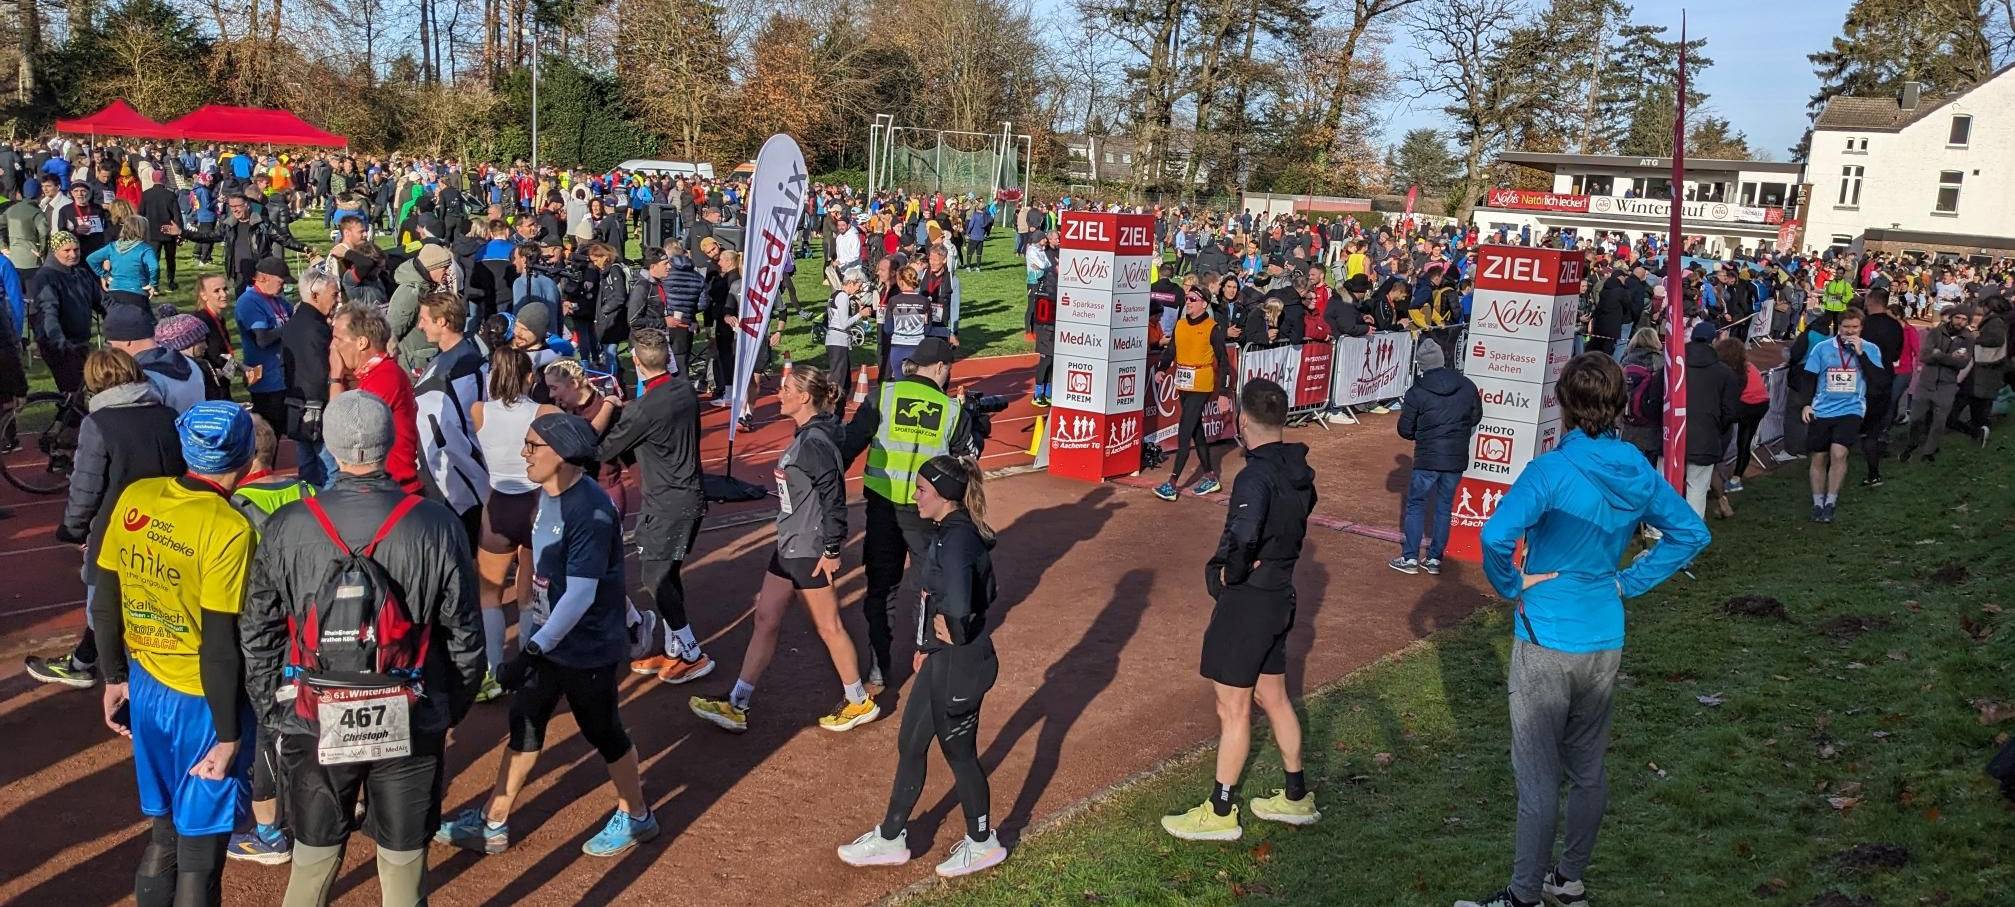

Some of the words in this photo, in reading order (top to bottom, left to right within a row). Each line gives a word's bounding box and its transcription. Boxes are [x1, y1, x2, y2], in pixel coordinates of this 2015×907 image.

[1640, 158, 1659, 166] ATG
[1492, 187, 1520, 206] Nobis
[1559, 195, 1587, 207] lecker!
[1065, 220, 1110, 241] ZIEL
[1119, 226, 1150, 246] ZIEL
[738, 160, 808, 338] MedAix
[1064, 255, 1110, 285] Nobis
[1118, 260, 1149, 290] Nobis
[1482, 255, 1549, 283] ZIEL
[1559, 260, 1579, 284] ZIEL
[1072, 300, 1105, 310] Sparkasse
[1072, 310, 1096, 319] Aachen
[1477, 299, 1546, 333] Nobis
[1060, 331, 1102, 347] MedAix
[1113, 336, 1143, 350] MedAix
[1489, 350, 1536, 364] Sparkasse
[1068, 362, 1093, 371] PHOTO
[1118, 366, 1136, 374] PHOTO
[1488, 362, 1522, 374] Aachen
[1177, 371, 1191, 379] 1248
[1357, 360, 1399, 397] Winterlauf
[1066, 394, 1091, 403] PREIM
[1116, 397, 1134, 406] PREIM
[1478, 424, 1514, 436] PHOTO
[1111, 441, 1131, 455] Aachener
[1473, 462, 1510, 475] PREIM
[150, 518, 175, 533] post
[147, 530, 195, 557] apotheke
[120, 544, 181, 587] chike
[340, 705, 387, 728] 467
[342, 730, 389, 742] Christoph
